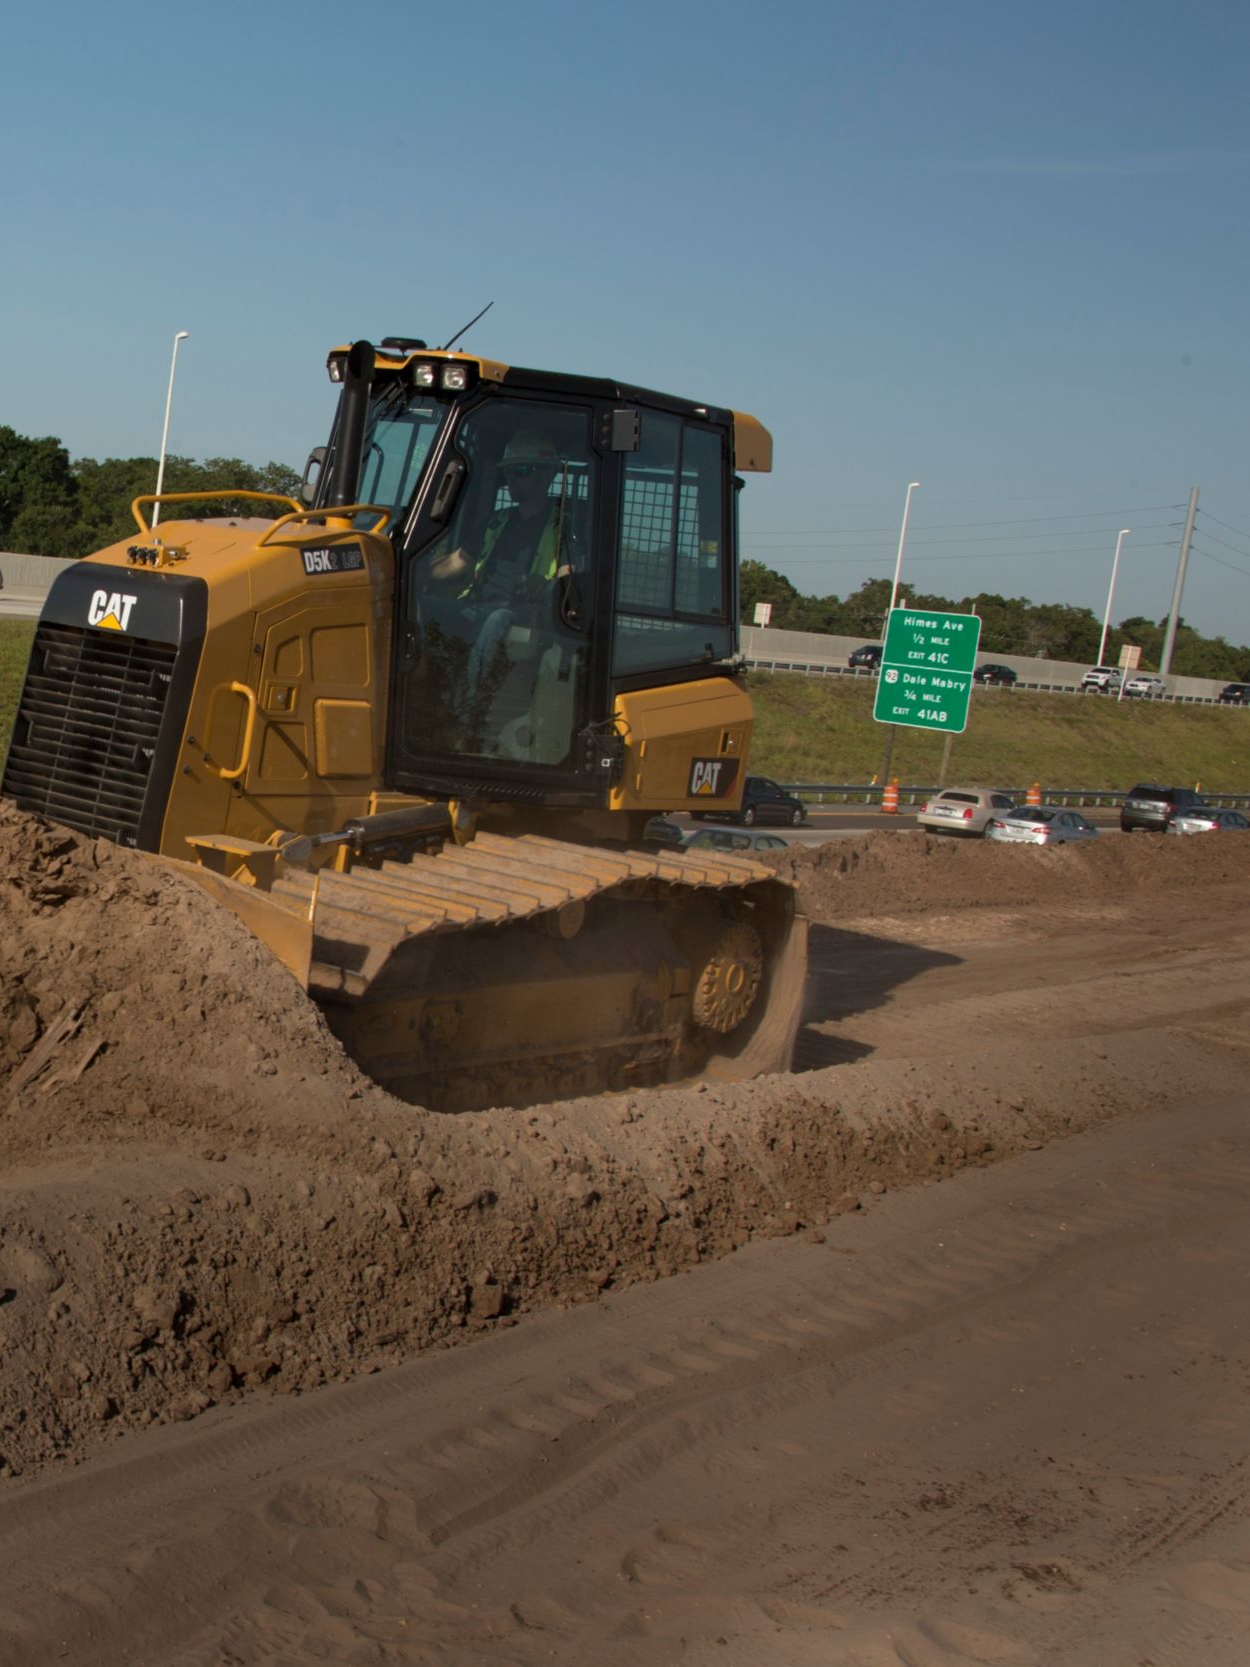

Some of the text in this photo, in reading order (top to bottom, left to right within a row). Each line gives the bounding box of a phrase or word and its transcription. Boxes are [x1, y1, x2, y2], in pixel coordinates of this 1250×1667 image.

[88, 589, 138, 632] CAT
[904, 616, 964, 631] Himes Ave
[931, 636, 950, 646] MILE
[908, 651, 949, 664] EXIT 41C
[886, 671, 966, 692] 92 Dale Mabry
[923, 694, 942, 703] MILE
[892, 706, 948, 722] EXIT 41AB
[691, 761, 722, 794] CAT
